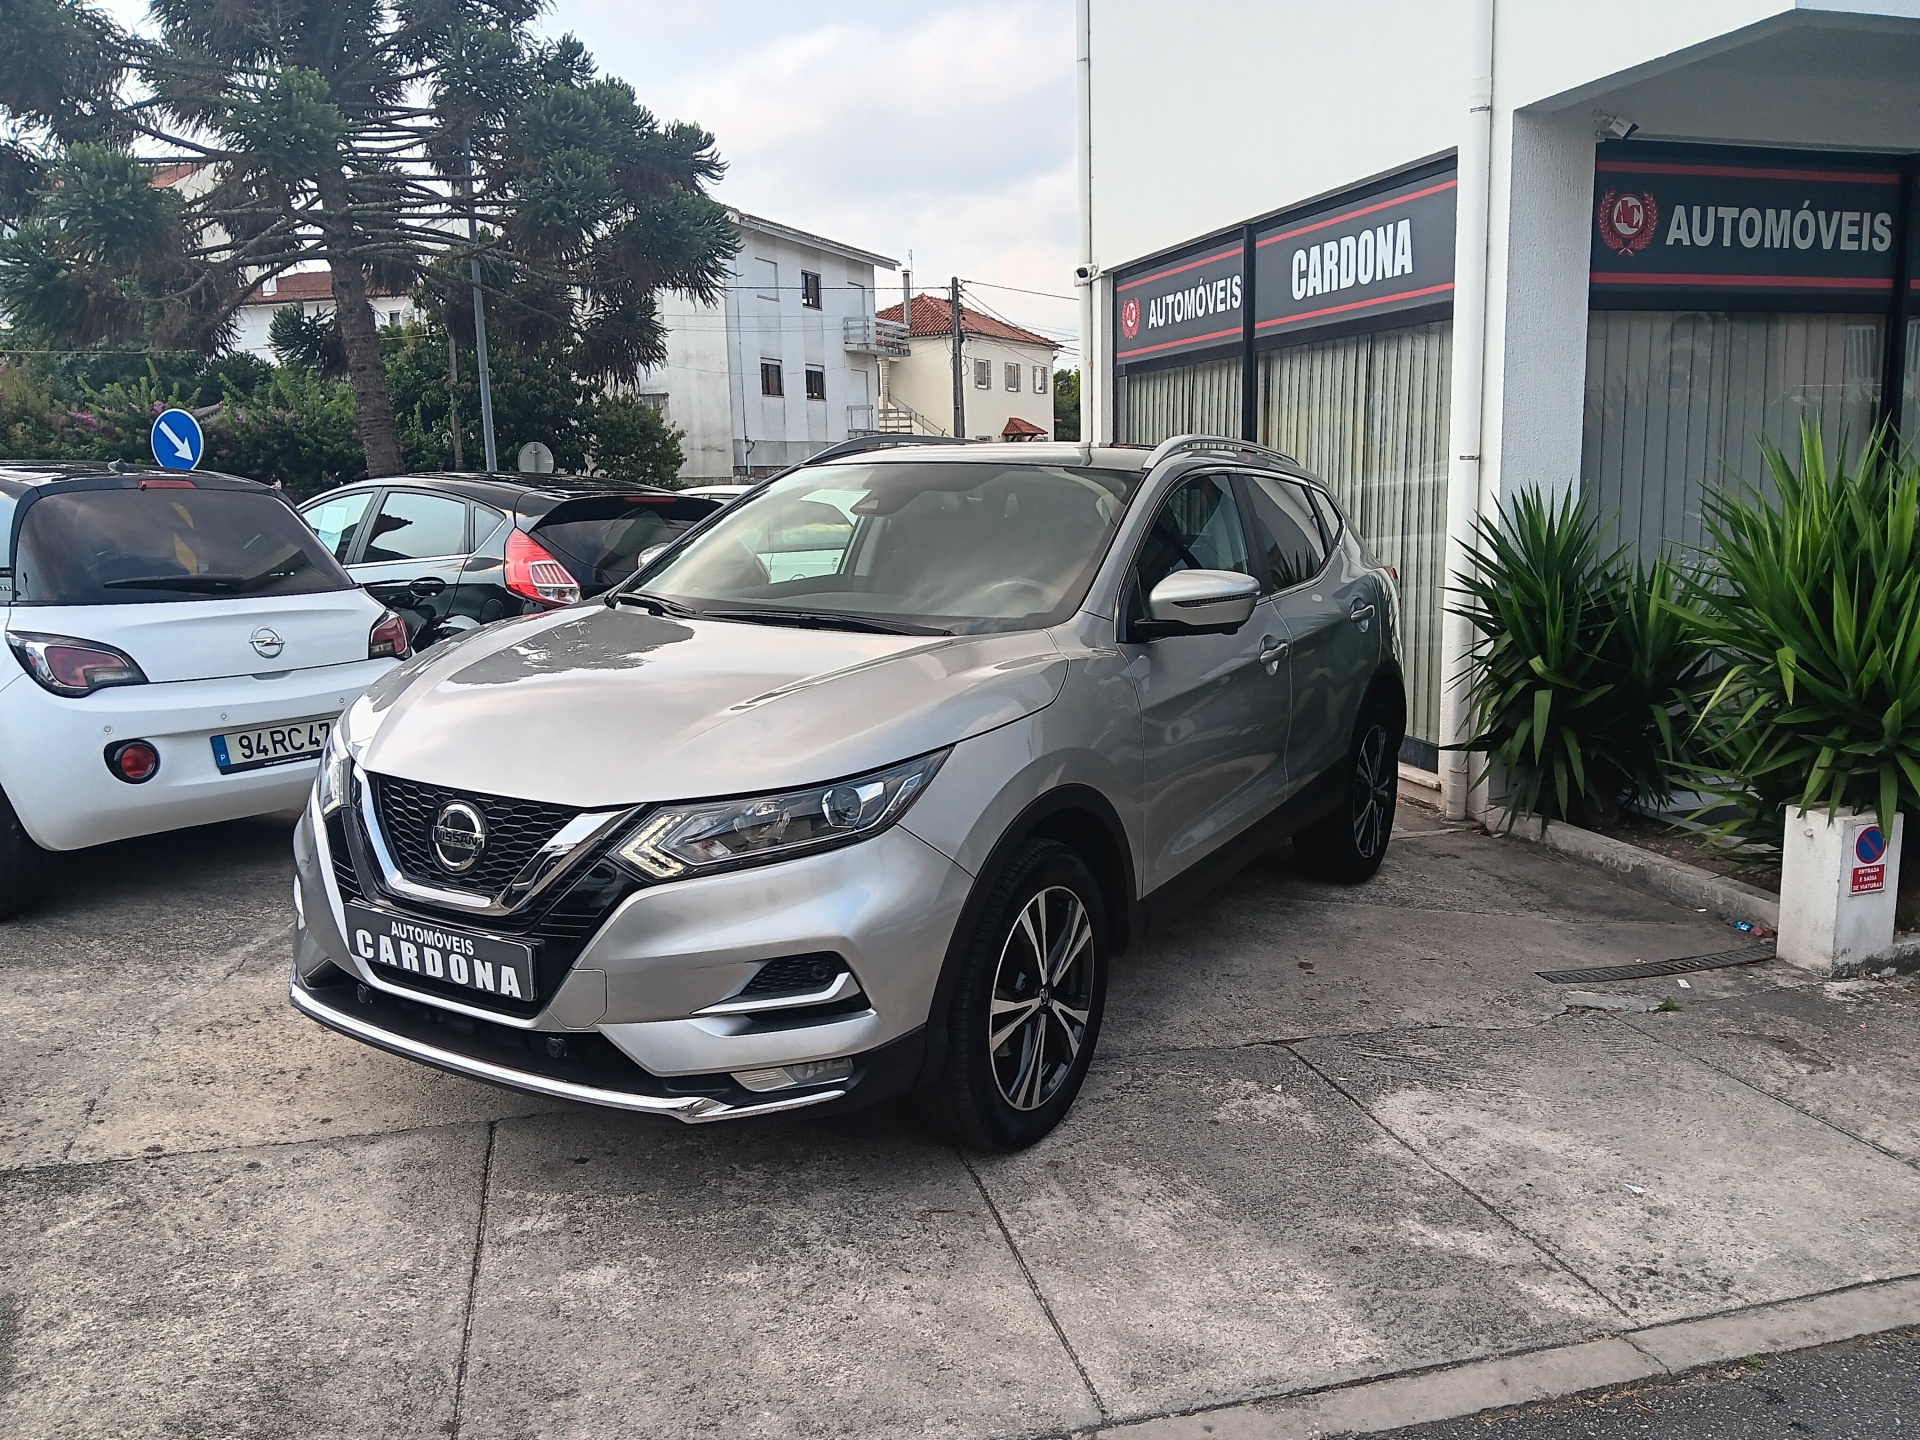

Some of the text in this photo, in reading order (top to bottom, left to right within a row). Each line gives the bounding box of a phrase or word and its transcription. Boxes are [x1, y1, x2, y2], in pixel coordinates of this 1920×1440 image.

[1665, 201, 1892, 252] AUTOMÓVEIS
[1291, 218, 1413, 301] CARDONA
[1148, 275, 1242, 330] AUTOMÓVEIS
[238, 722, 330, 759] 94RC47
[437, 828, 478, 846] NISSAN
[1860, 882, 1883, 890] VIATURAS
[390, 920, 474, 956] AUTOMÓVEIS
[355, 929, 522, 998] CARDONA
